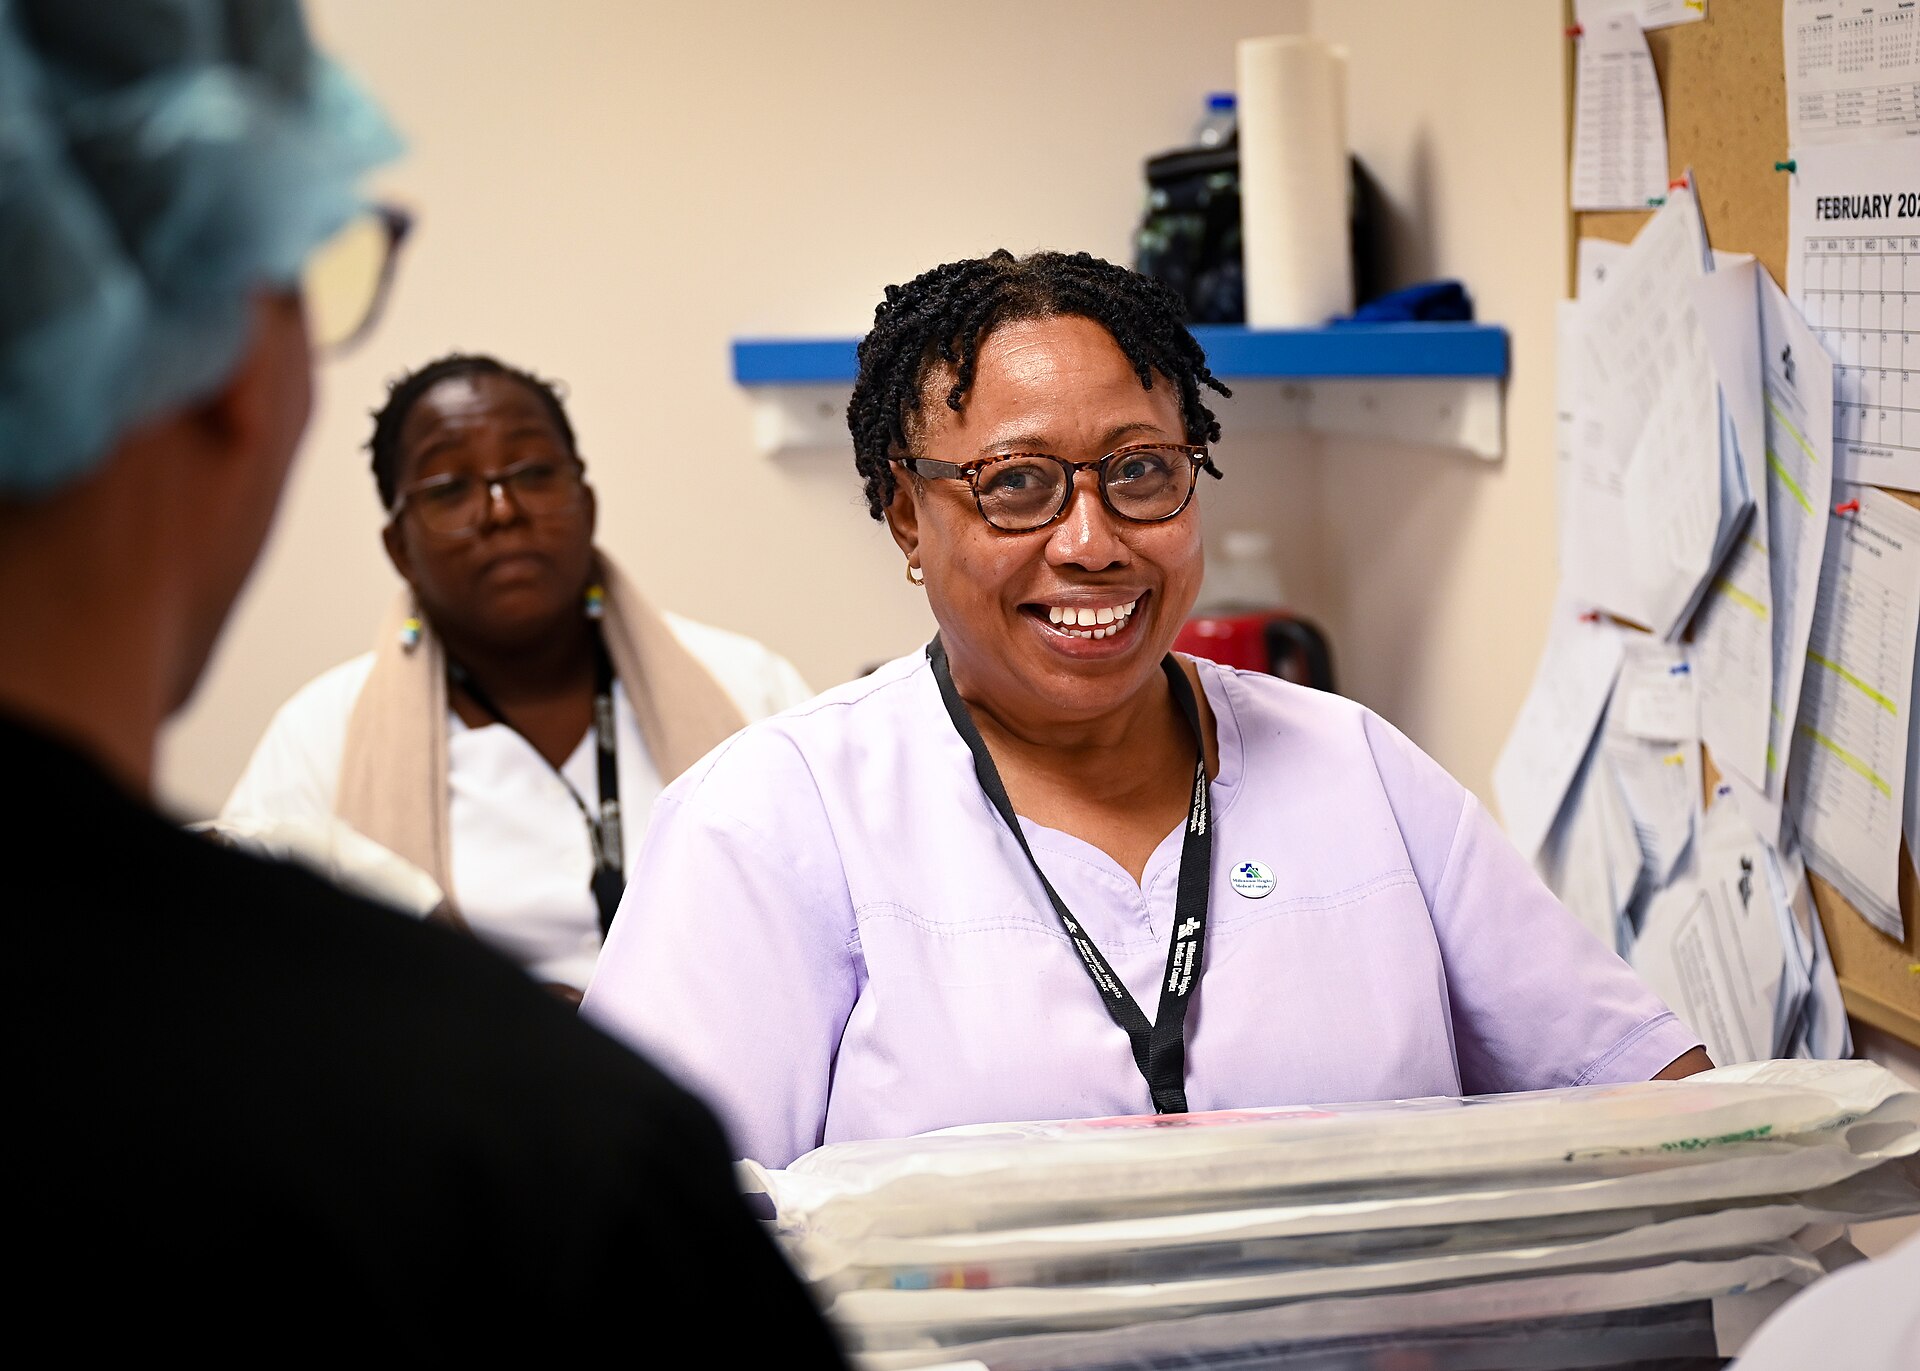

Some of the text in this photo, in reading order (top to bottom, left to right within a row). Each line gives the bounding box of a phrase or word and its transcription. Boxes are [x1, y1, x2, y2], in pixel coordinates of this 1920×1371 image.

[1816, 193, 1893, 220] FEBRUARY
[1080, 939, 1123, 999] Millennium Heights
[1088, 964, 1110, 992] Complex
[1168, 941, 1187, 993] Medical Complex
[1177, 940, 1197, 997] Millennium Heights
